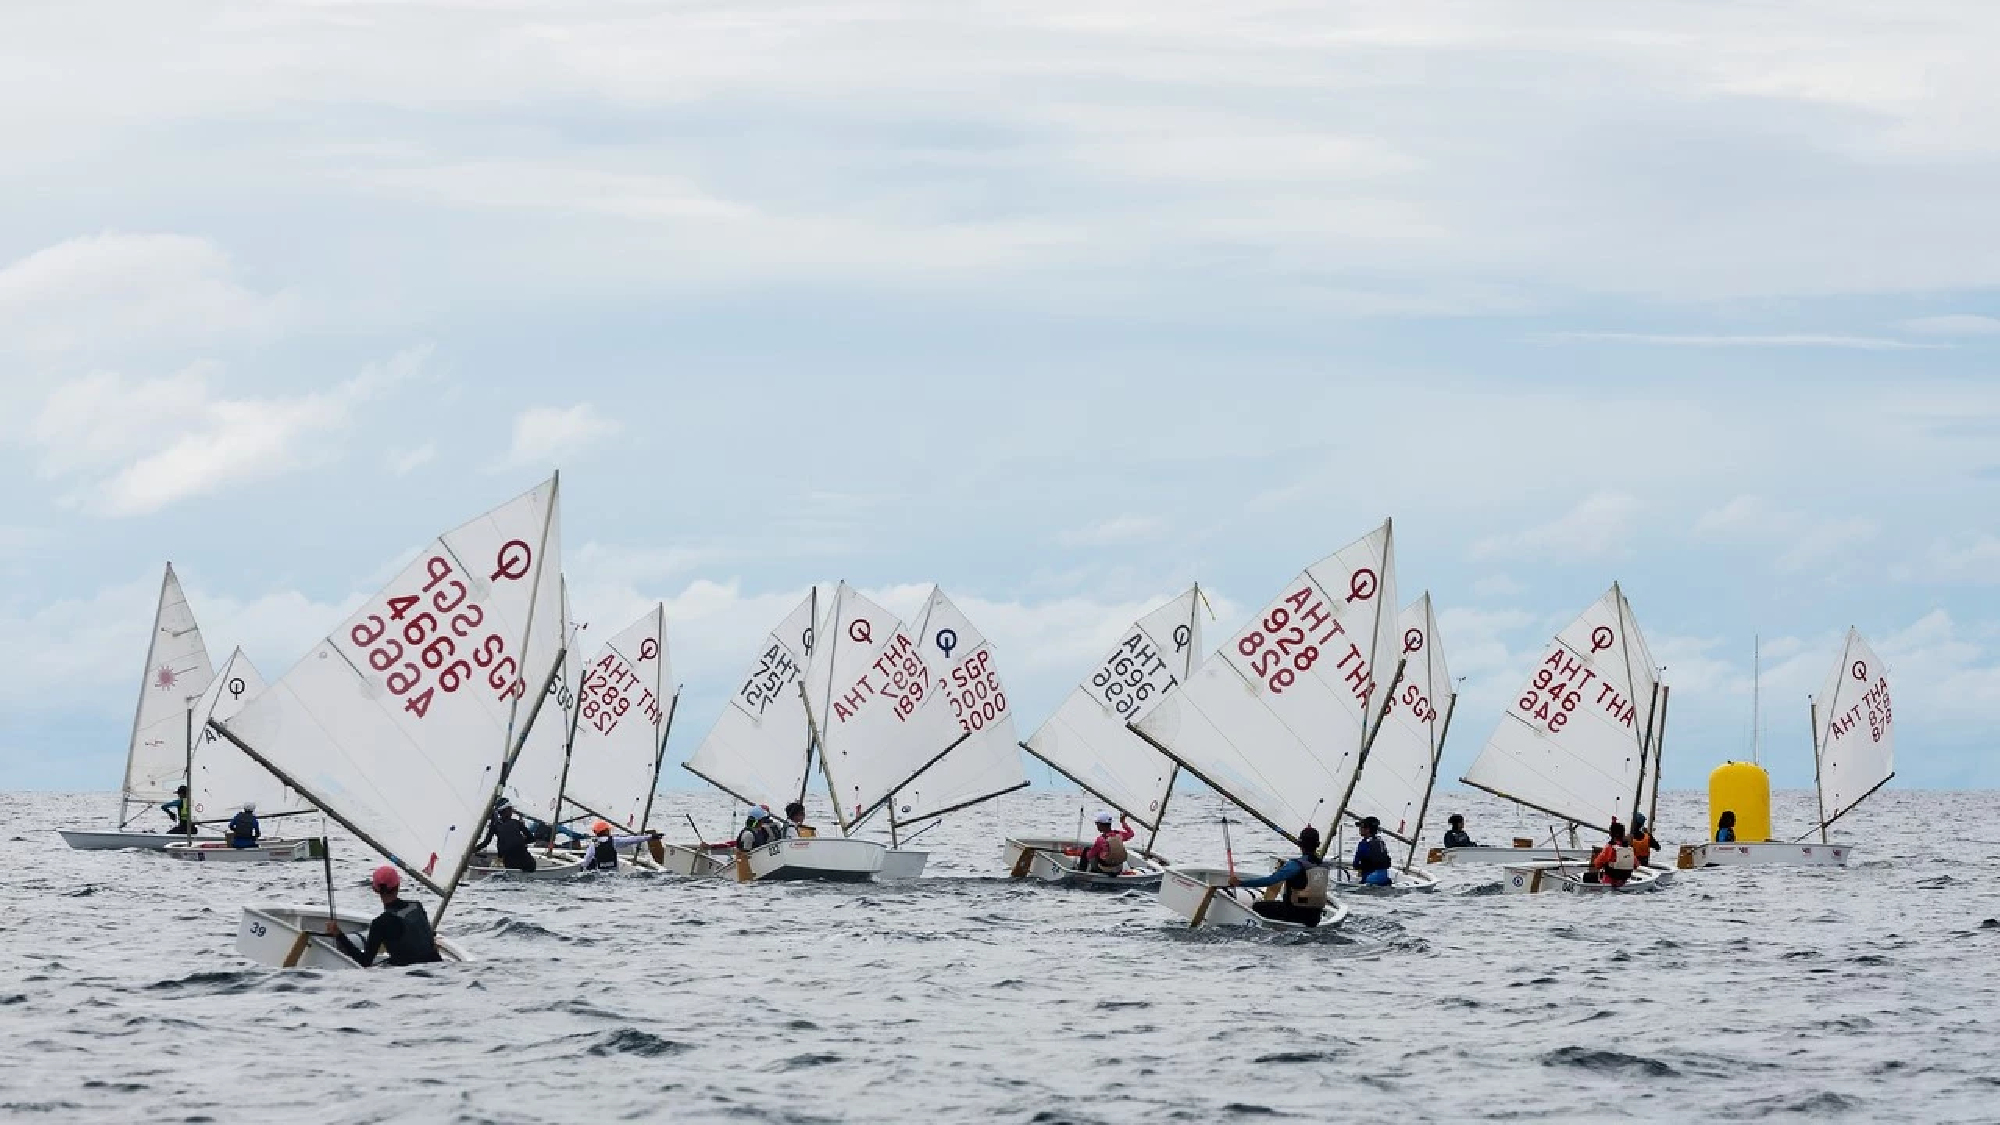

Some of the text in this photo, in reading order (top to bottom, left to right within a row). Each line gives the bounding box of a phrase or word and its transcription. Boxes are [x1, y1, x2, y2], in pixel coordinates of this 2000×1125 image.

[387, 594, 471, 693] 4666
[872, 633, 912, 677] THA
[1263, 607, 1320, 671] 928
[473, 633, 526, 702] SGP
[582, 668, 630, 718] 1289
[893, 666, 930, 722] 1897
[951, 650, 989, 688] SGP
[1336, 643, 1377, 710] THA
[1402, 684, 1437, 724] SGP
[1532, 668, 1582, 723] 946
[1596, 681, 1636, 729] THA
